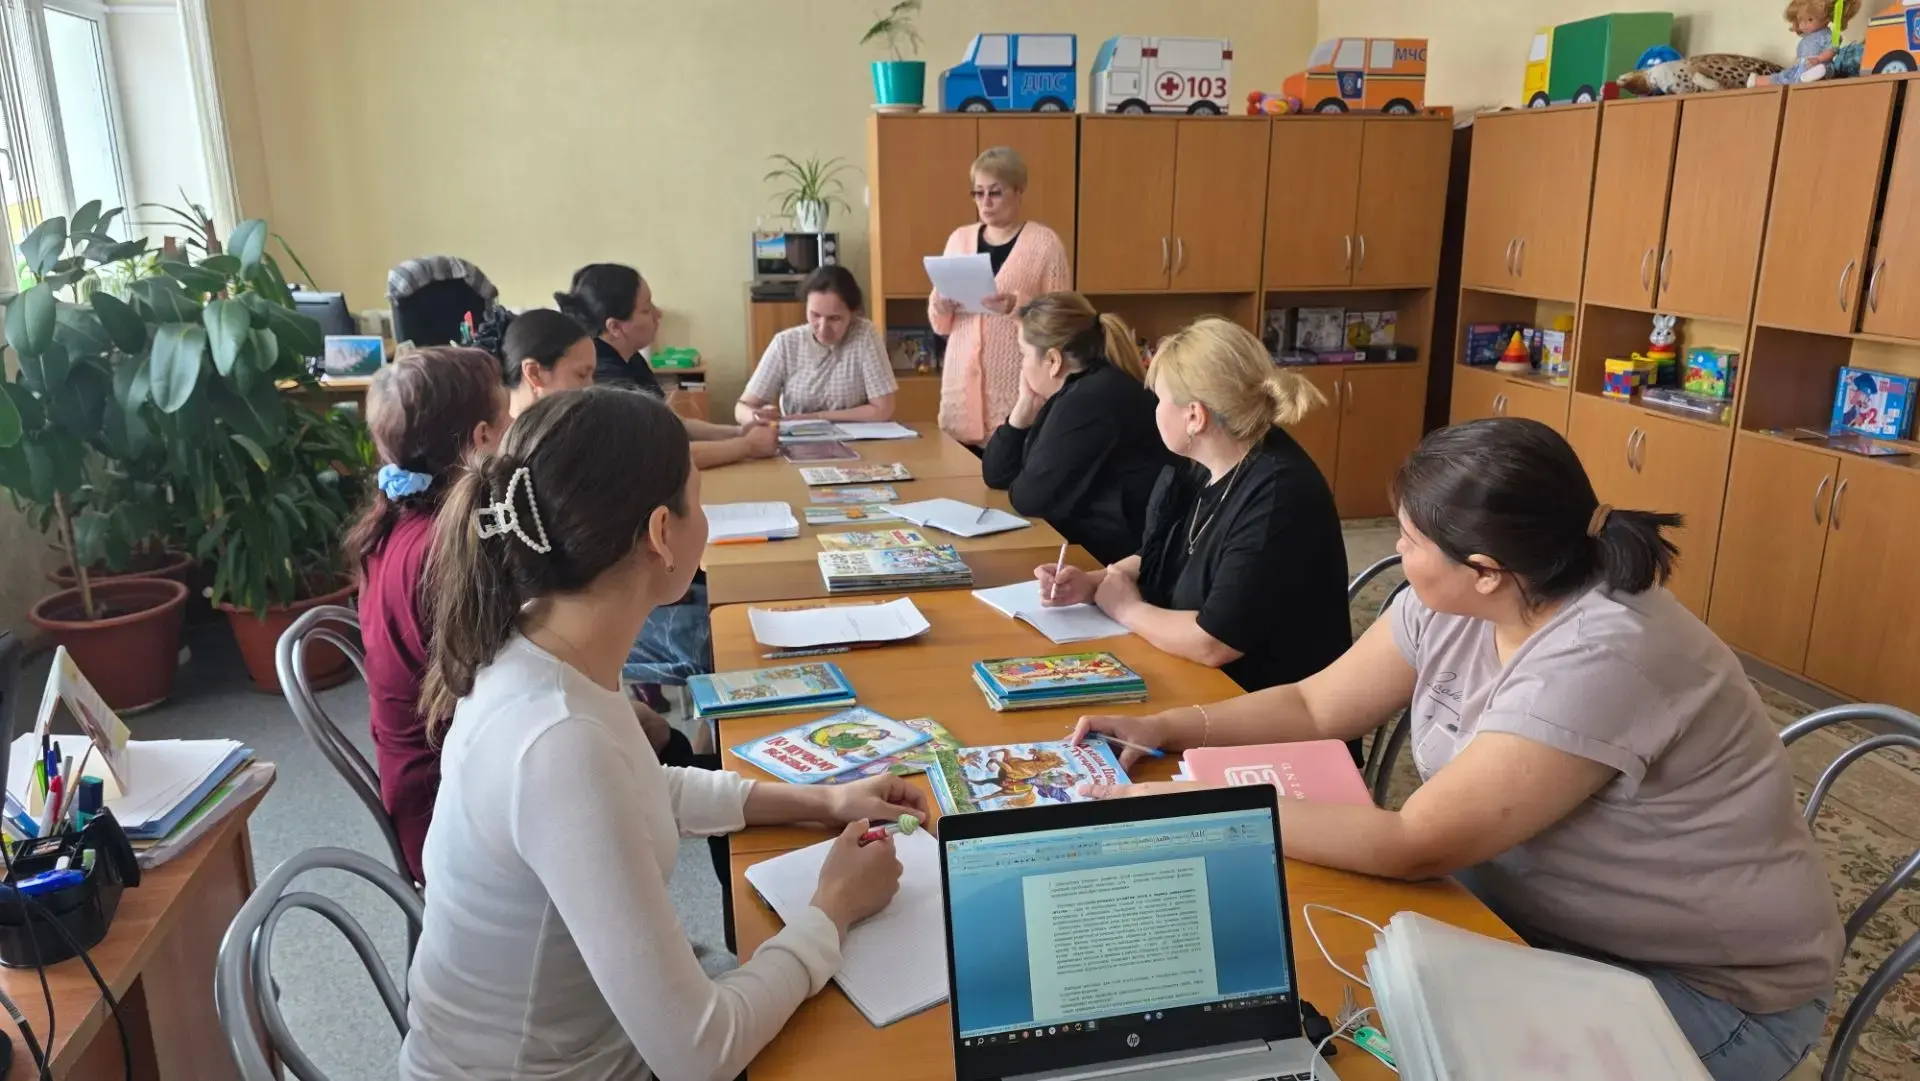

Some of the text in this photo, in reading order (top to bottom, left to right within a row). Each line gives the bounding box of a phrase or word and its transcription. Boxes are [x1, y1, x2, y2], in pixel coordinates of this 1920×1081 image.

[1021, 72, 1067, 95] ДПС
[1187, 76, 1227, 98] 103
[764, 736, 789, 747] ПО
[1127, 1033, 1140, 1047] hp
